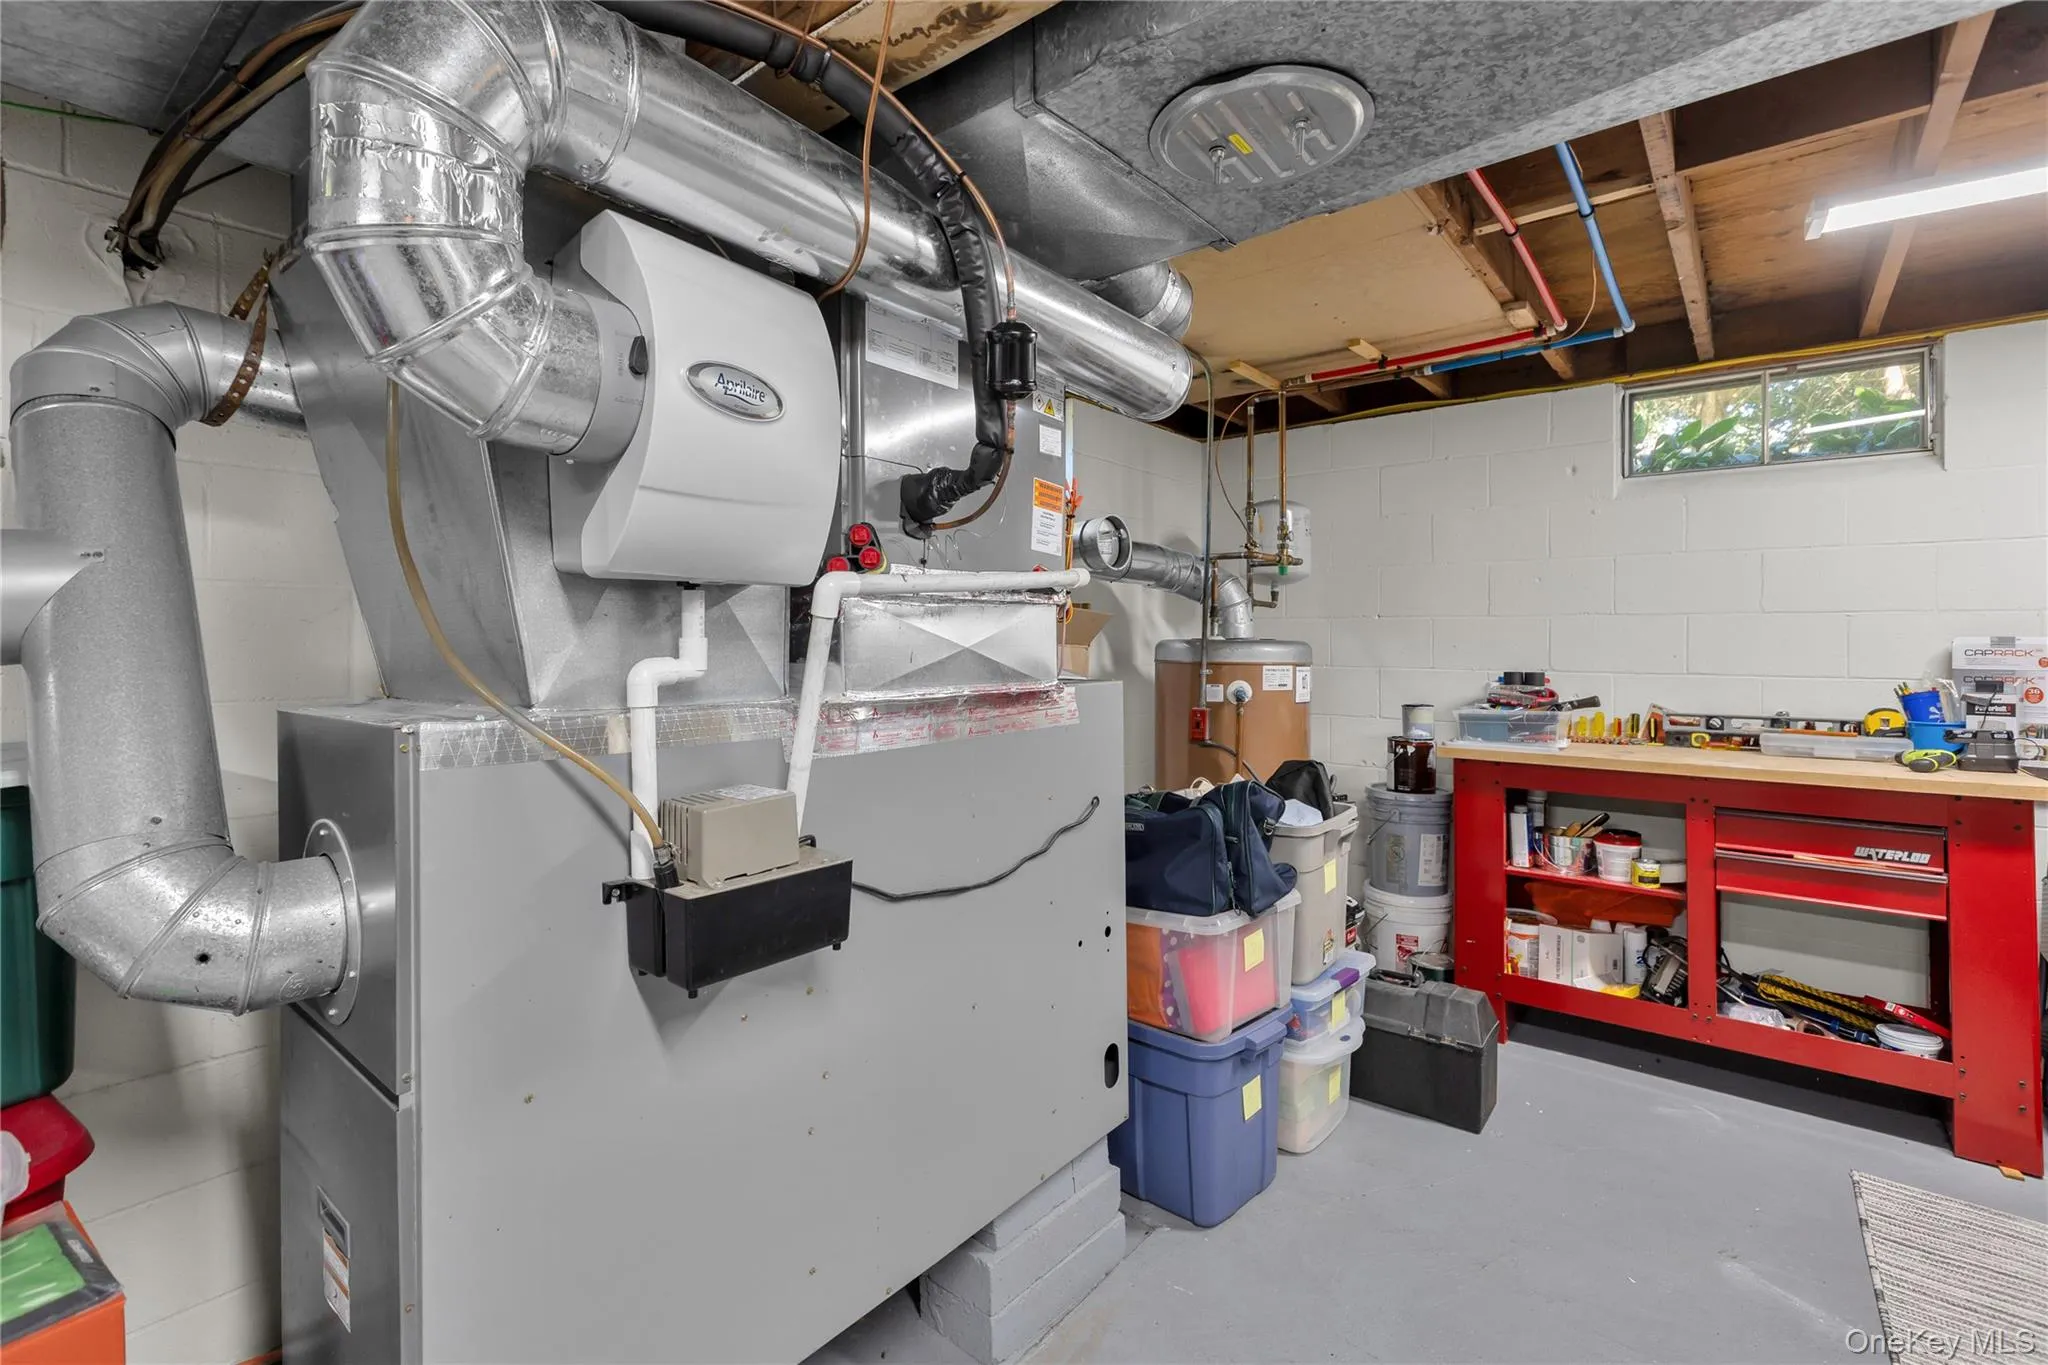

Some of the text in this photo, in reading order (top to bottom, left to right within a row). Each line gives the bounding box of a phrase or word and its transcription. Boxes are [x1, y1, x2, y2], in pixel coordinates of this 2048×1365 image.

[714, 373, 766, 405] Aprilaire
[1964, 649, 2034, 657] CAPRACK
[1854, 846, 1931, 864] WATERLOO
